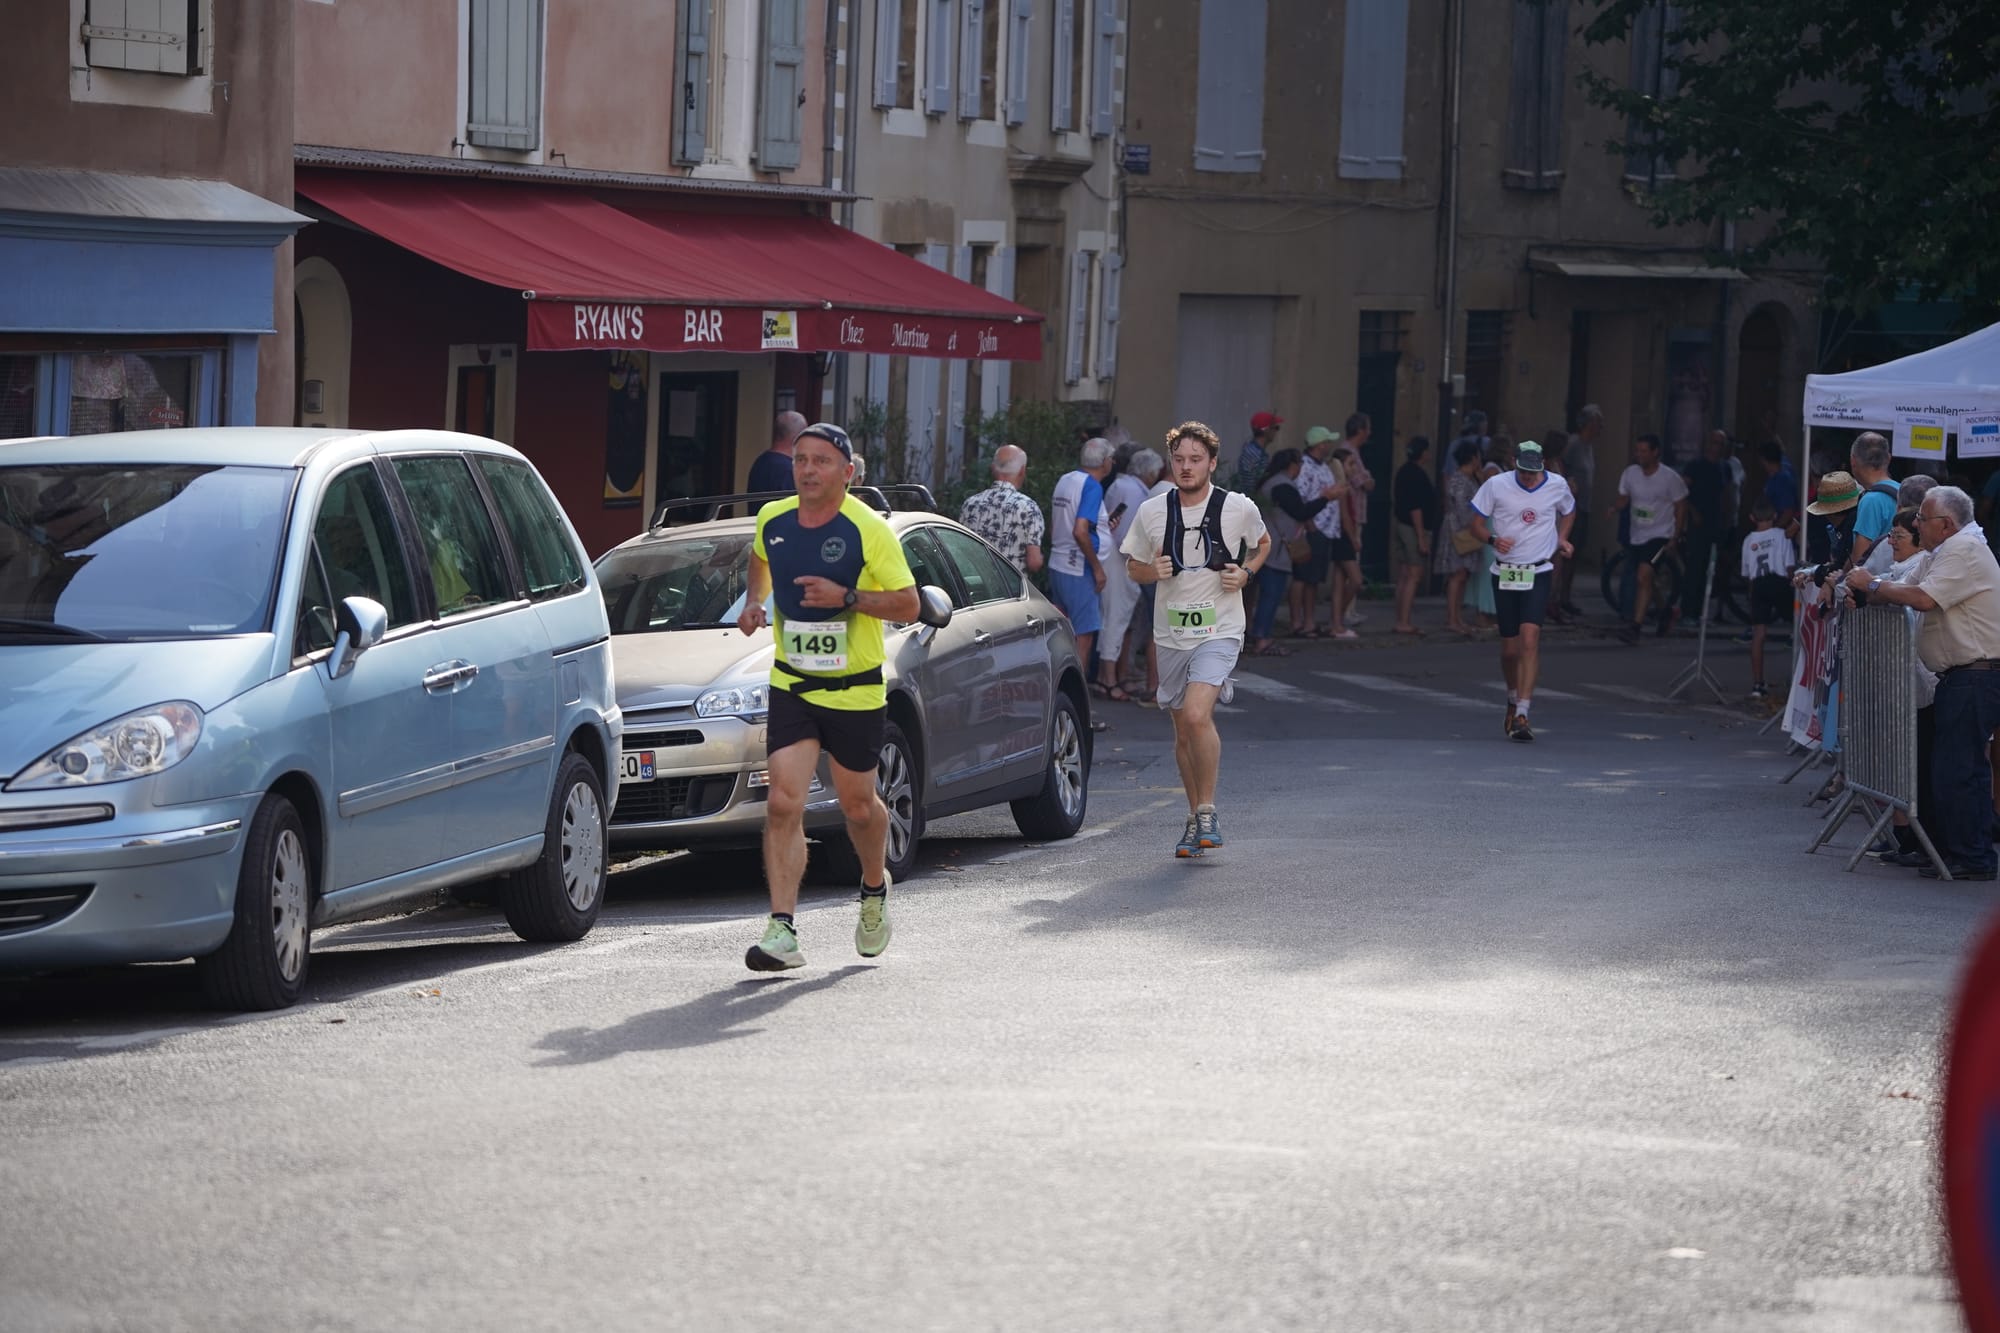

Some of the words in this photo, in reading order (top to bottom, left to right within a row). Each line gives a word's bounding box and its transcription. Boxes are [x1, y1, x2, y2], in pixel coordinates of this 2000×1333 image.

[574, 304, 644, 341] RYAN'S
[683, 308, 723, 342] BAR
[840, 315, 865, 345] Chez
[891, 322, 930, 349] Martine
[947, 329, 958, 350] et
[976, 326, 998, 357] John
[1508, 570, 1523, 582] 31
[1178, 612, 1203, 627] 70
[792, 634, 837, 654] 149
[642, 766, 653, 777] 48
